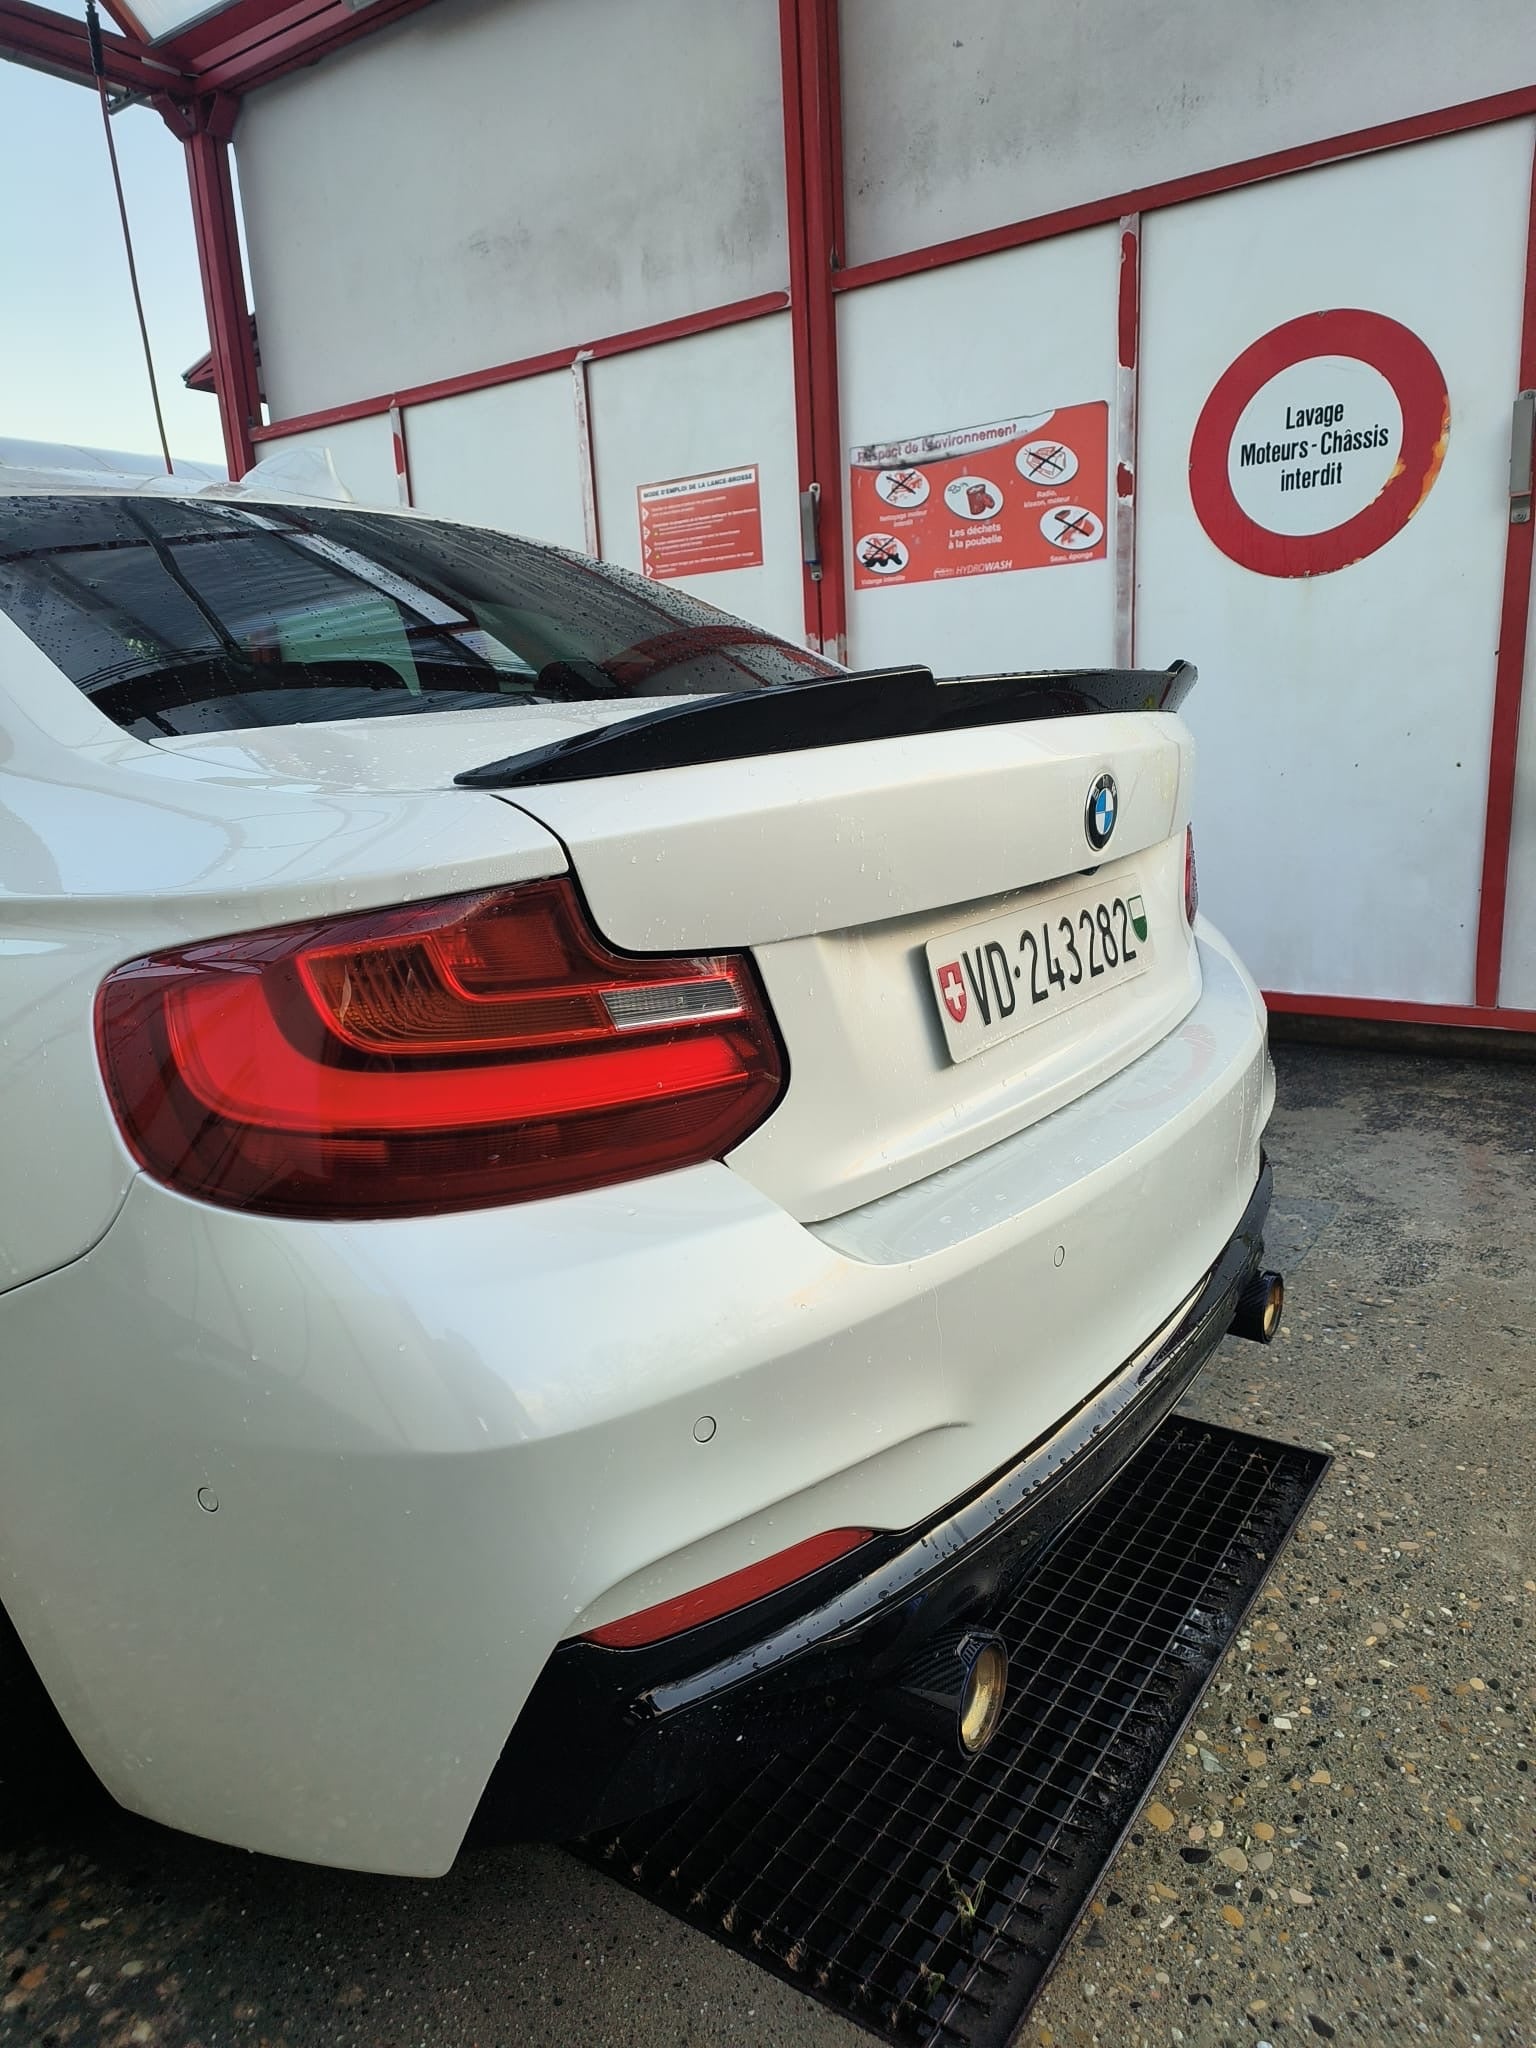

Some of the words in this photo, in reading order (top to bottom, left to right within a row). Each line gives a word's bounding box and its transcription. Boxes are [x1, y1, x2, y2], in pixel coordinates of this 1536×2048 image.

[1285, 403, 1344, 430] Lavage
[904, 441, 919, 455] de
[1240, 440, 1308, 467] Moteurs
[1320, 424, 1389, 455] Châssis
[1280, 462, 1343, 492] interdit
[949, 529, 965, 538] Les
[966, 523, 1001, 536] déchets
[955, 539, 964, 548] la
[965, 534, 1003, 549] poubelle
